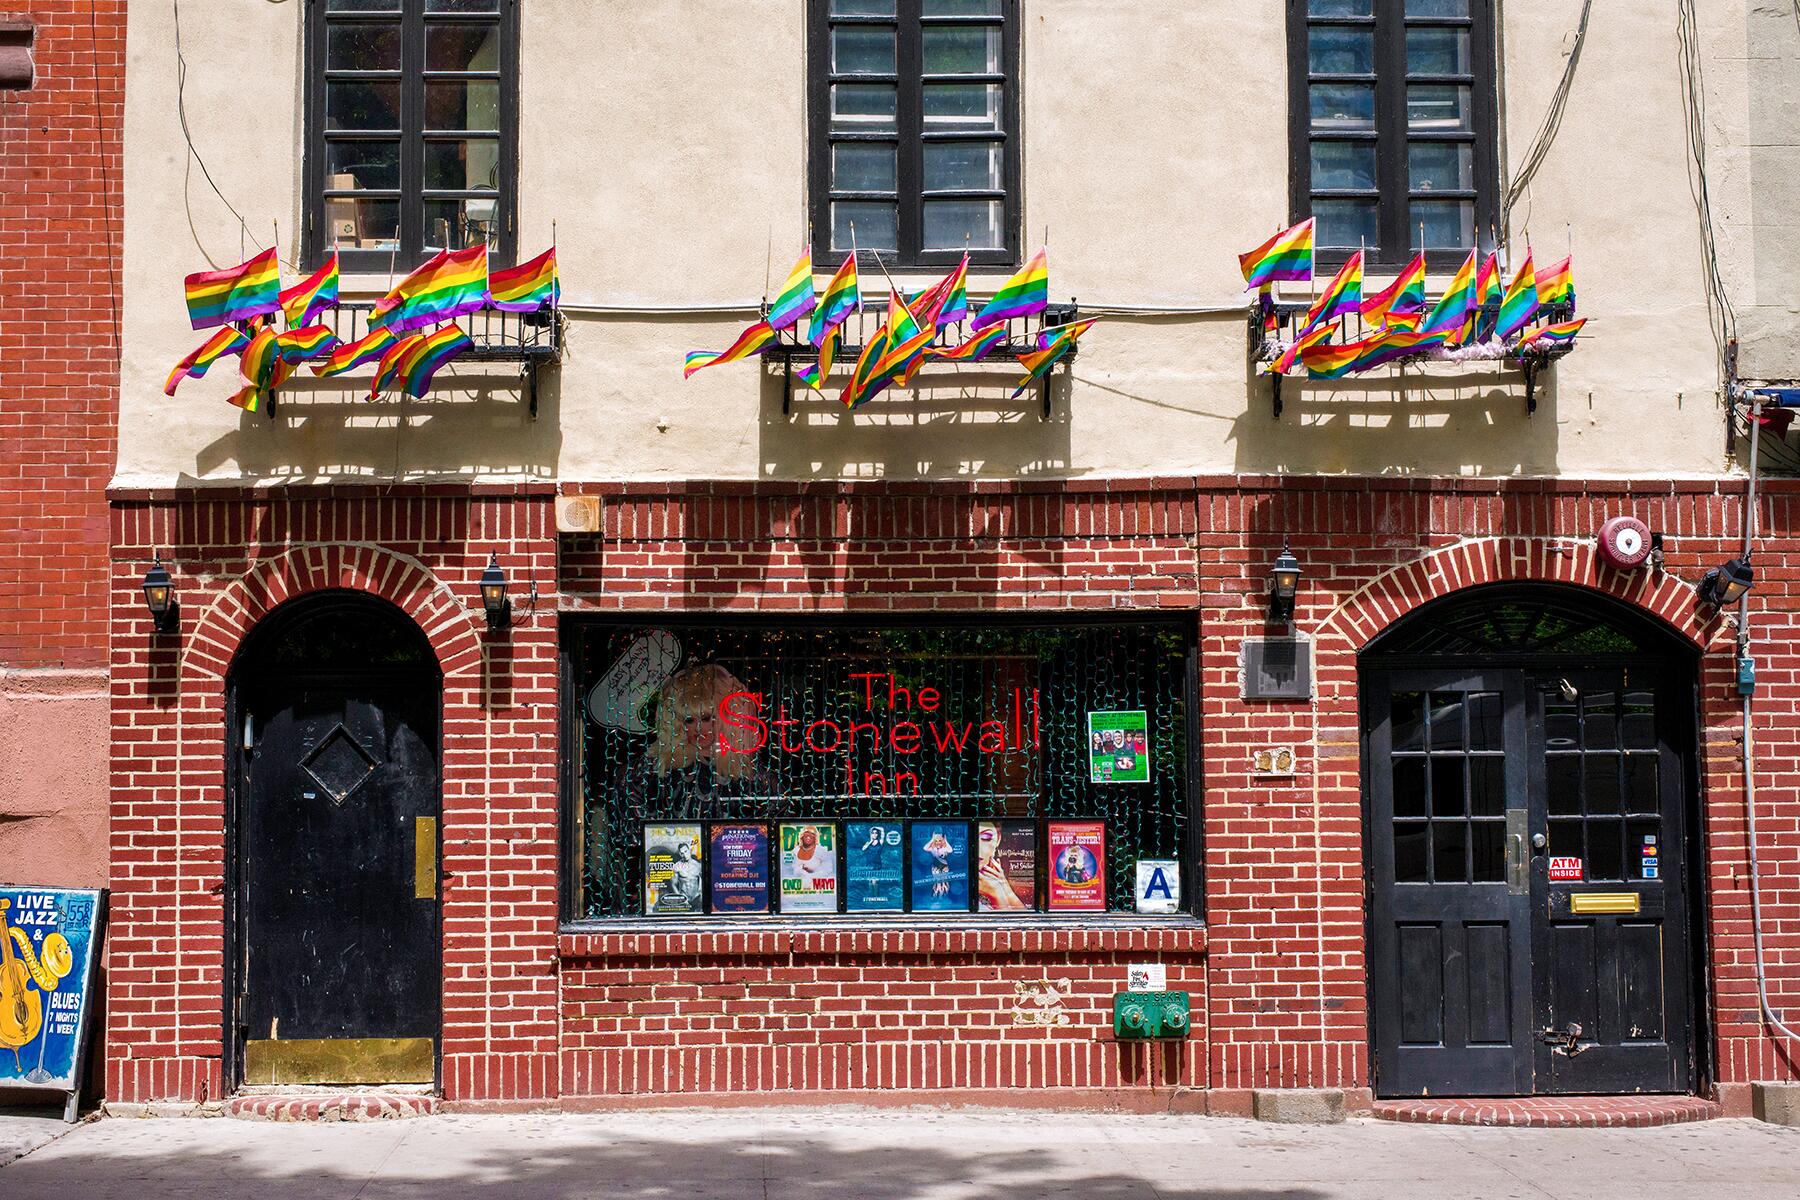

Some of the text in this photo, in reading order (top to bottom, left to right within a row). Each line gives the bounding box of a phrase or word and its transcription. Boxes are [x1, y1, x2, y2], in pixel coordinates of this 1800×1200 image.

[848, 674, 940, 712] The
[719, 688, 1038, 756] Stonewall
[848, 758, 918, 797] Inn
[1052, 836, 1100, 844] TRANS-JESTER!
[1551, 858, 1579, 868] ATM
[783, 878, 834, 890] CINCO MAYO
[1144, 868, 1172, 899] A
[17, 895, 54, 909] LIVE
[15, 911, 58, 925] JAZZ
[69, 905, 84, 922] 55
[33, 929, 43, 940] &
[51, 992, 80, 1010] BLUES
[1123, 993, 1181, 1002] AUTO SPKR
[49, 1012, 78, 1024] 7 NIGHTS
[49, 1024, 75, 1035] A WEEK
